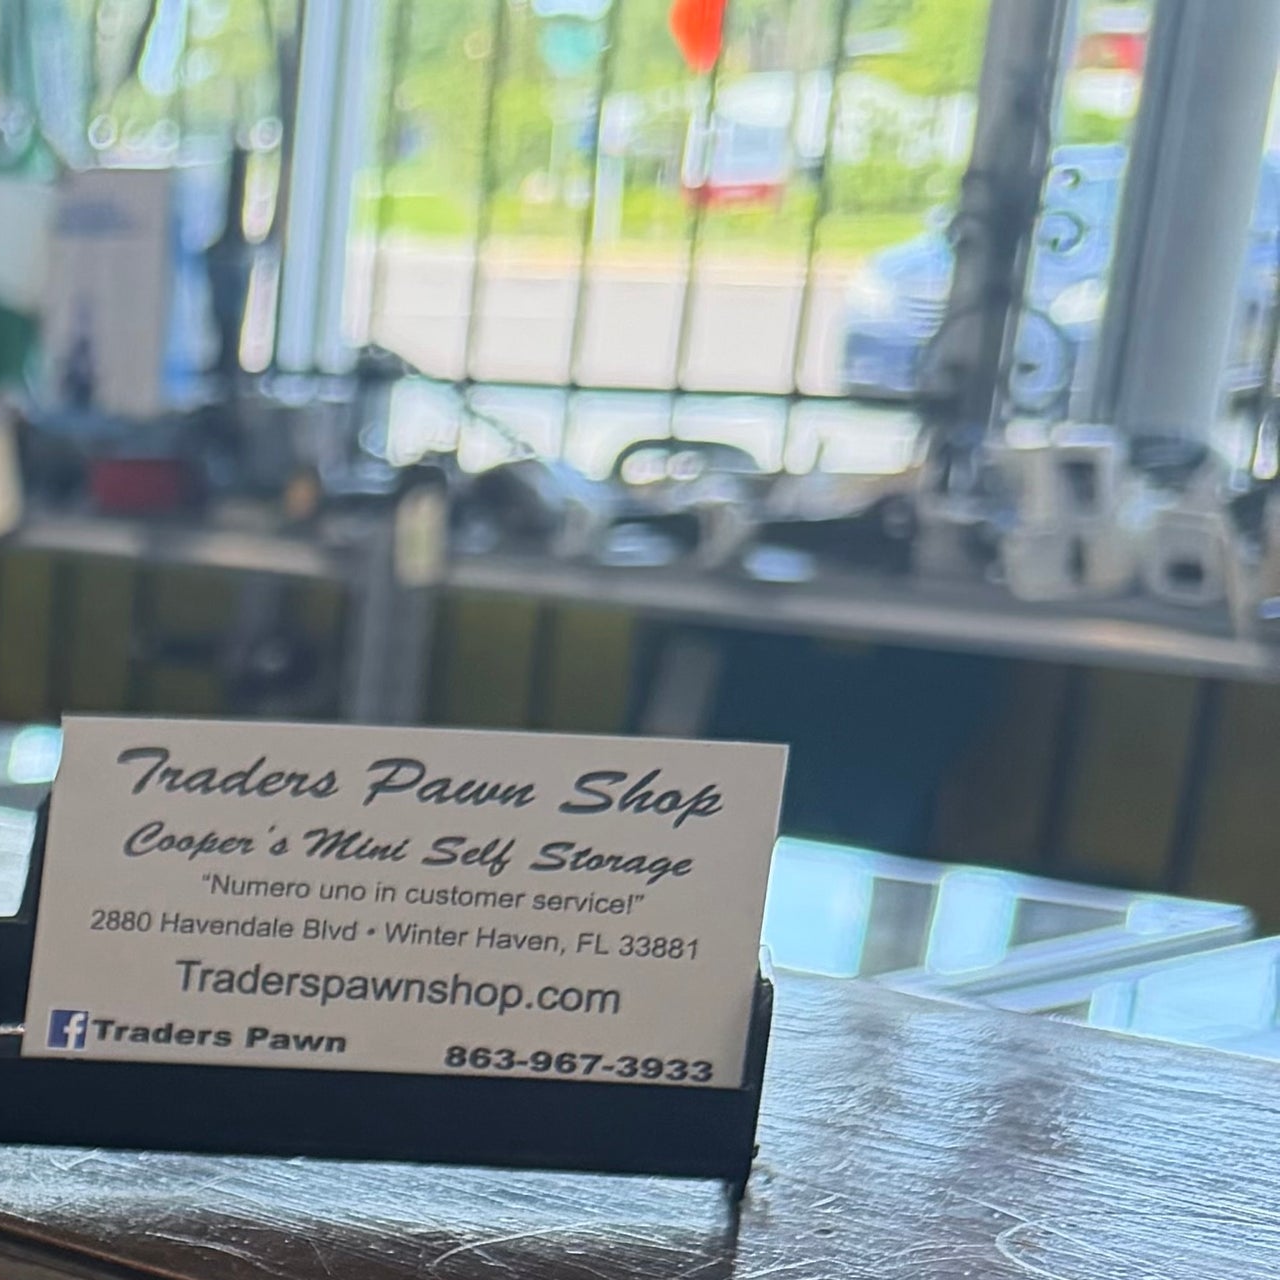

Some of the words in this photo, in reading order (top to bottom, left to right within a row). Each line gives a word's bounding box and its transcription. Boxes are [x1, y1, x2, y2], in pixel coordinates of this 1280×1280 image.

[117, 747, 339, 798] Traders
[363, 758, 536, 807] Pawn
[559, 769, 724, 829] Shop
[123, 820, 289, 860] Cooper's
[303, 827, 411, 862] Mini
[421, 836, 516, 877] Self
[528, 841, 694, 886] Storage
[319, 883, 366, 901] uno
[374, 882, 396, 902] in
[404, 886, 526, 909] customer
[90, 909, 151, 932] 2880
[160, 912, 294, 939] Havendale
[302, 918, 358, 941] Blvd
[384, 922, 468, 948] Winter
[475, 927, 566, 956] Haven,
[576, 933, 609, 955] FL
[618, 935, 699, 960] 33881
[175, 959, 621, 1016] Traderspawnshop.com
[92, 1019, 232, 1048] Traders
[245, 1026, 348, 1054] Pawn
[444, 1045, 714, 1083] 863-967-3933
